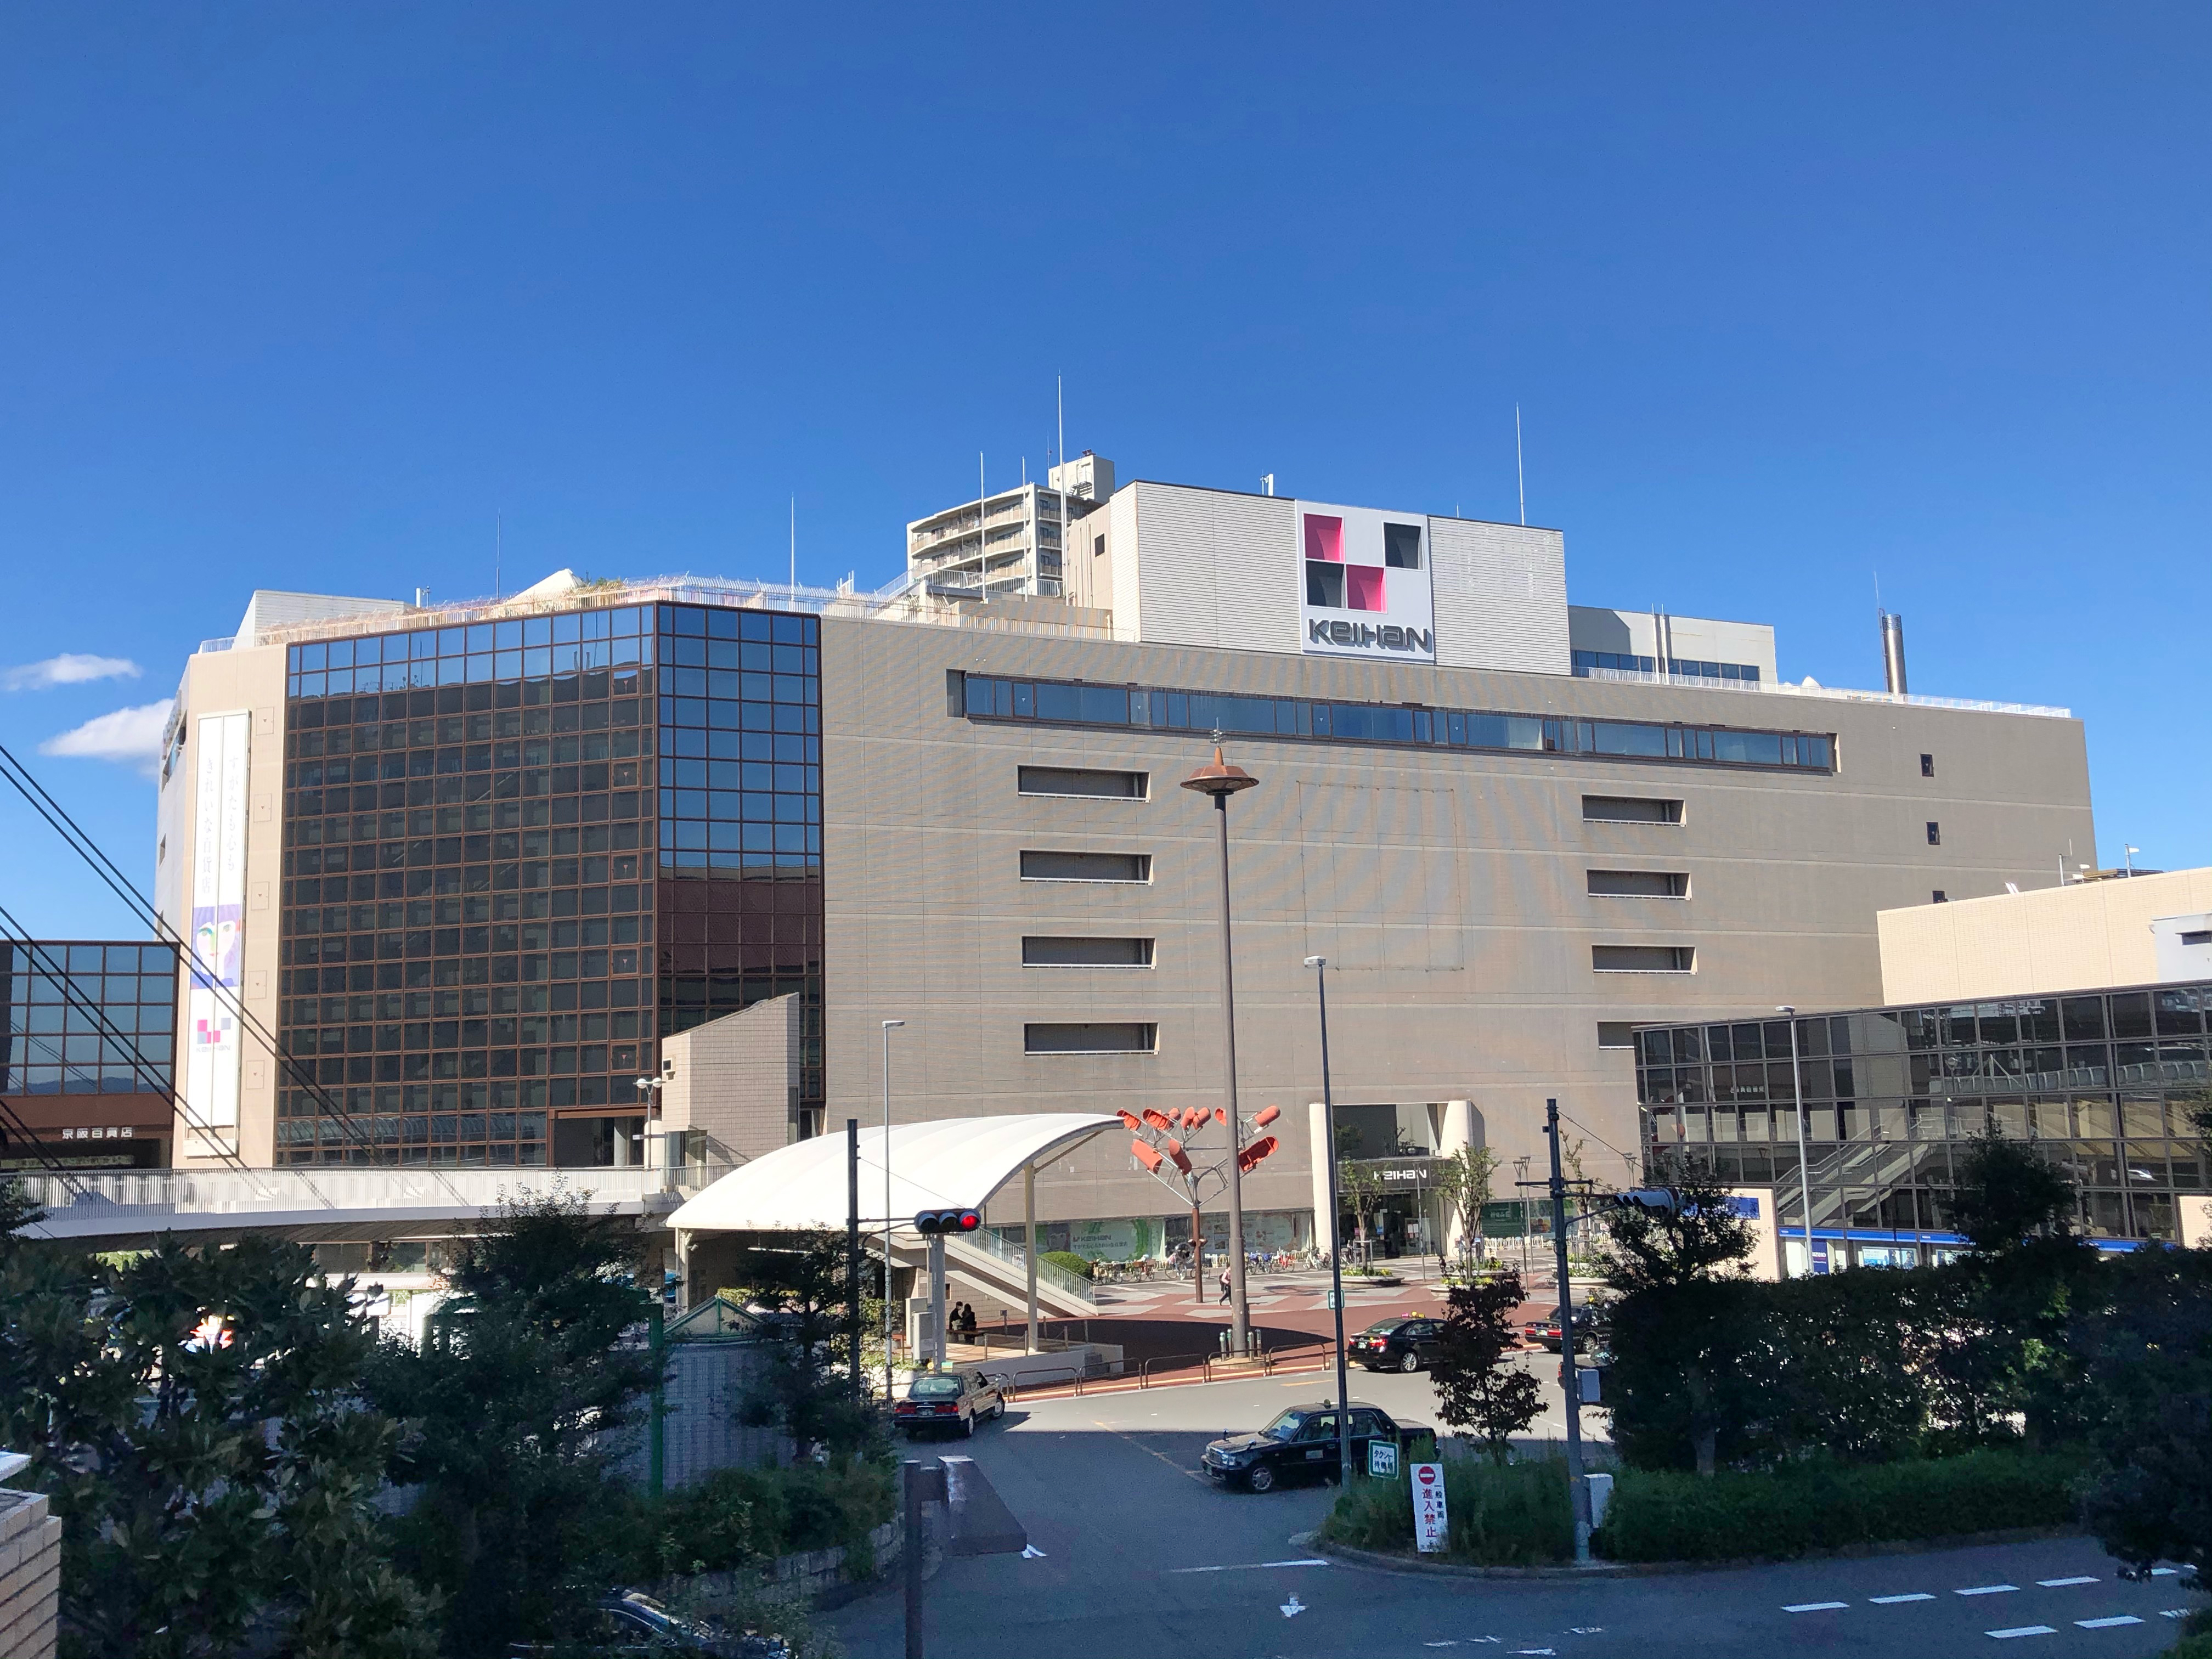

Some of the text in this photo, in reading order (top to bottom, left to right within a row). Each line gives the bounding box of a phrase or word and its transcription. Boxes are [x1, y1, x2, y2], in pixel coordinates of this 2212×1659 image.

[1308, 618, 1430, 650] KEIHAN
[62, 1127, 133, 1139] 京阪百貨店
[1421, 1487, 1437, 1538] 進入禁止
[1434, 1484, 1444, 1520] 一般車両
